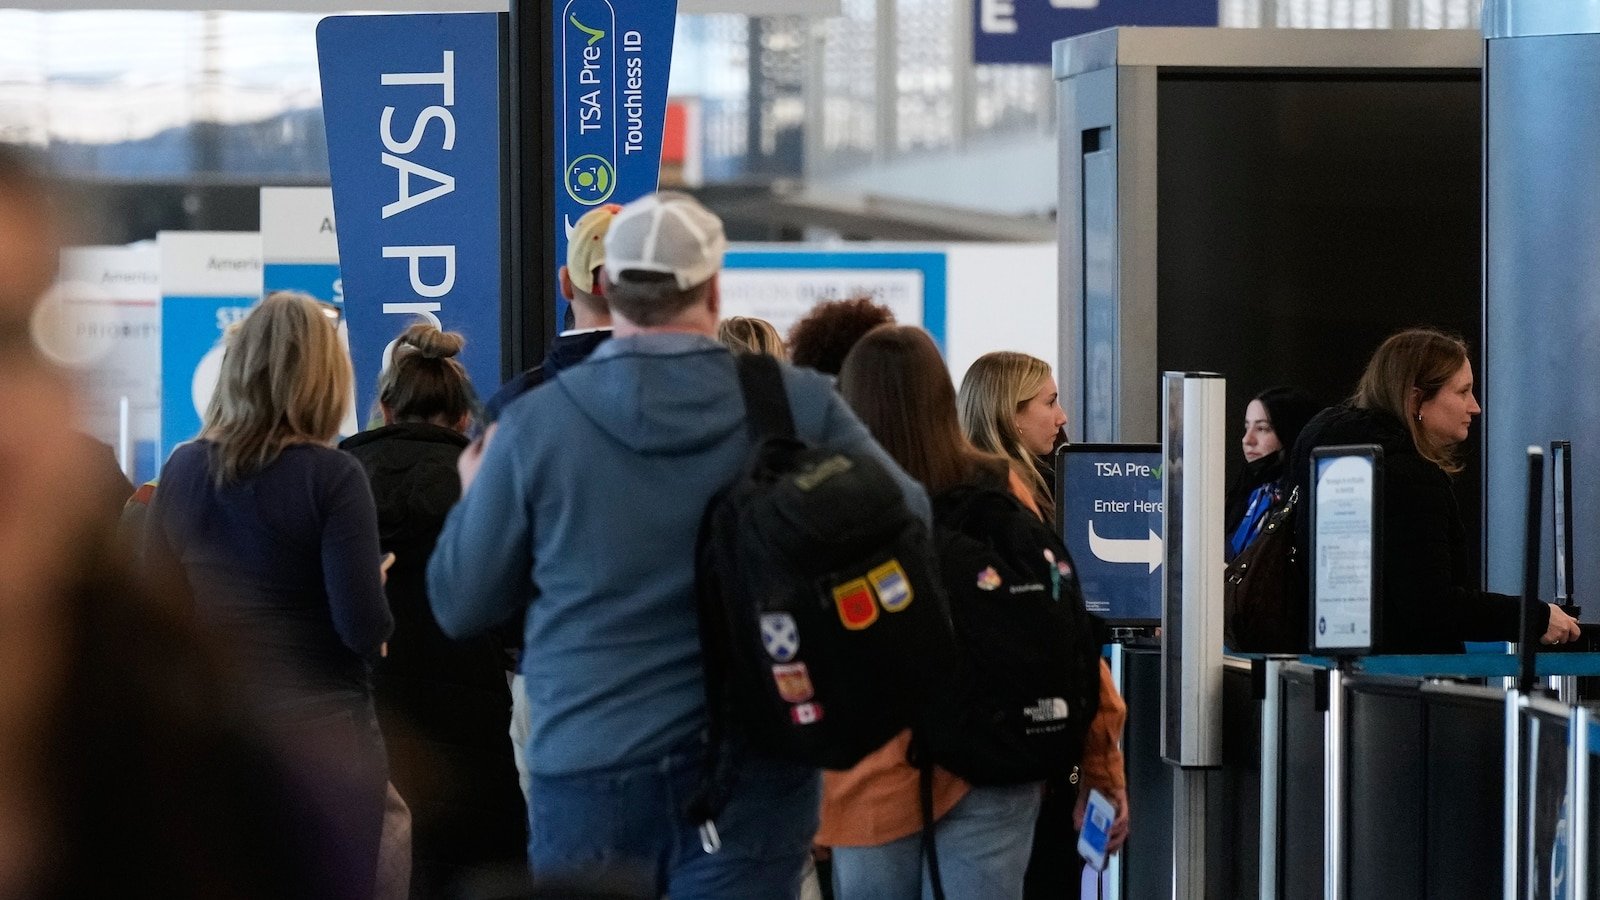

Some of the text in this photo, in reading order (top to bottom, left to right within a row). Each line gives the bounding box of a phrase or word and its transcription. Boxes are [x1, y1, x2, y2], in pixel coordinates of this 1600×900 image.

[580, 46, 602, 135] TSA Pre
[623, 30, 643, 155] Touchless ID
[380, 50, 456, 374] TSA Pr
[1094, 462, 1150, 477] TSA Pre
[1094, 500, 1163, 513] Enter Here
